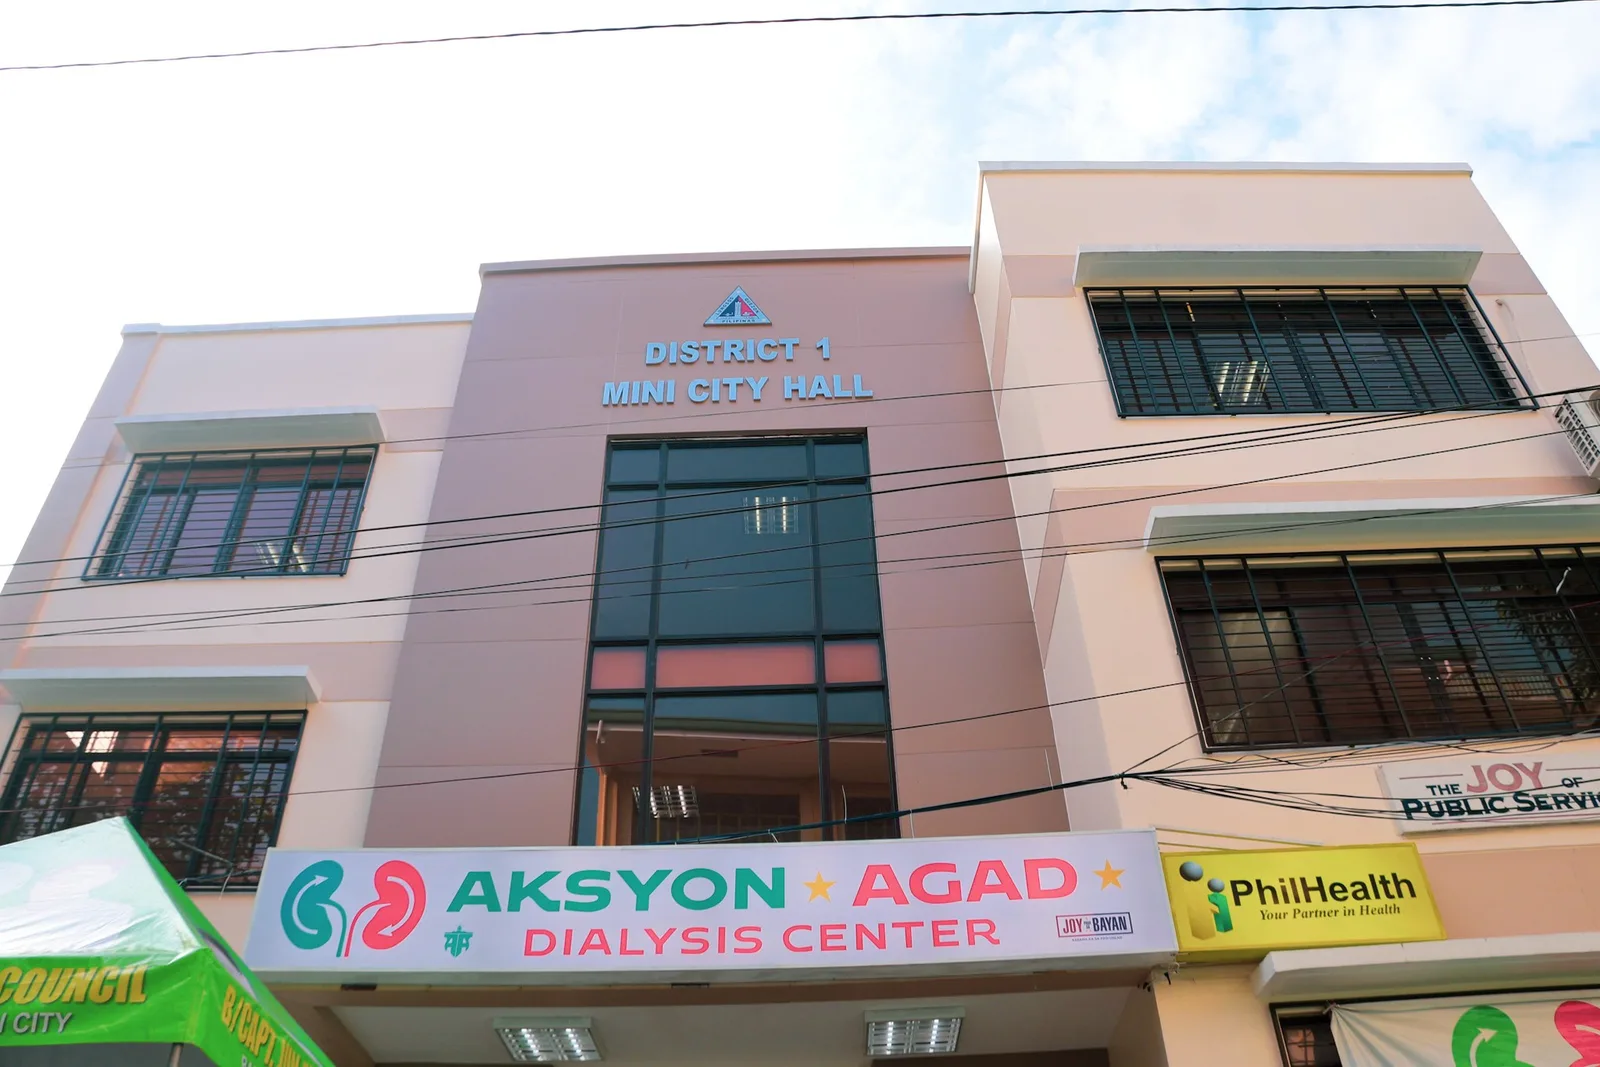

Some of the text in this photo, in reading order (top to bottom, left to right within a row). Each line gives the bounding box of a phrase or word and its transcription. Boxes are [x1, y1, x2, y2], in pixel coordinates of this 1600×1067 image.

[645, 336, 831, 365] DISTRICT 1
[602, 374, 874, 406] MINI CITY HALL
[1426, 762, 1583, 796] THE JOY OF
[1401, 797, 1509, 820] PUBLIC
[446, 858, 1077, 912] AKSYON AGAD
[1230, 873, 1417, 906] PhilHealth
[1063, 919, 1082, 934] JOY
[1092, 916, 1128, 932] BAYAN
[1259, 904, 1401, 921] Your Partner in Health
[523, 919, 1000, 957] DIALYSIS CENTER
[0, 966, 148, 1005] COUNCIL
[13, 1012, 72, 1034] CITY
